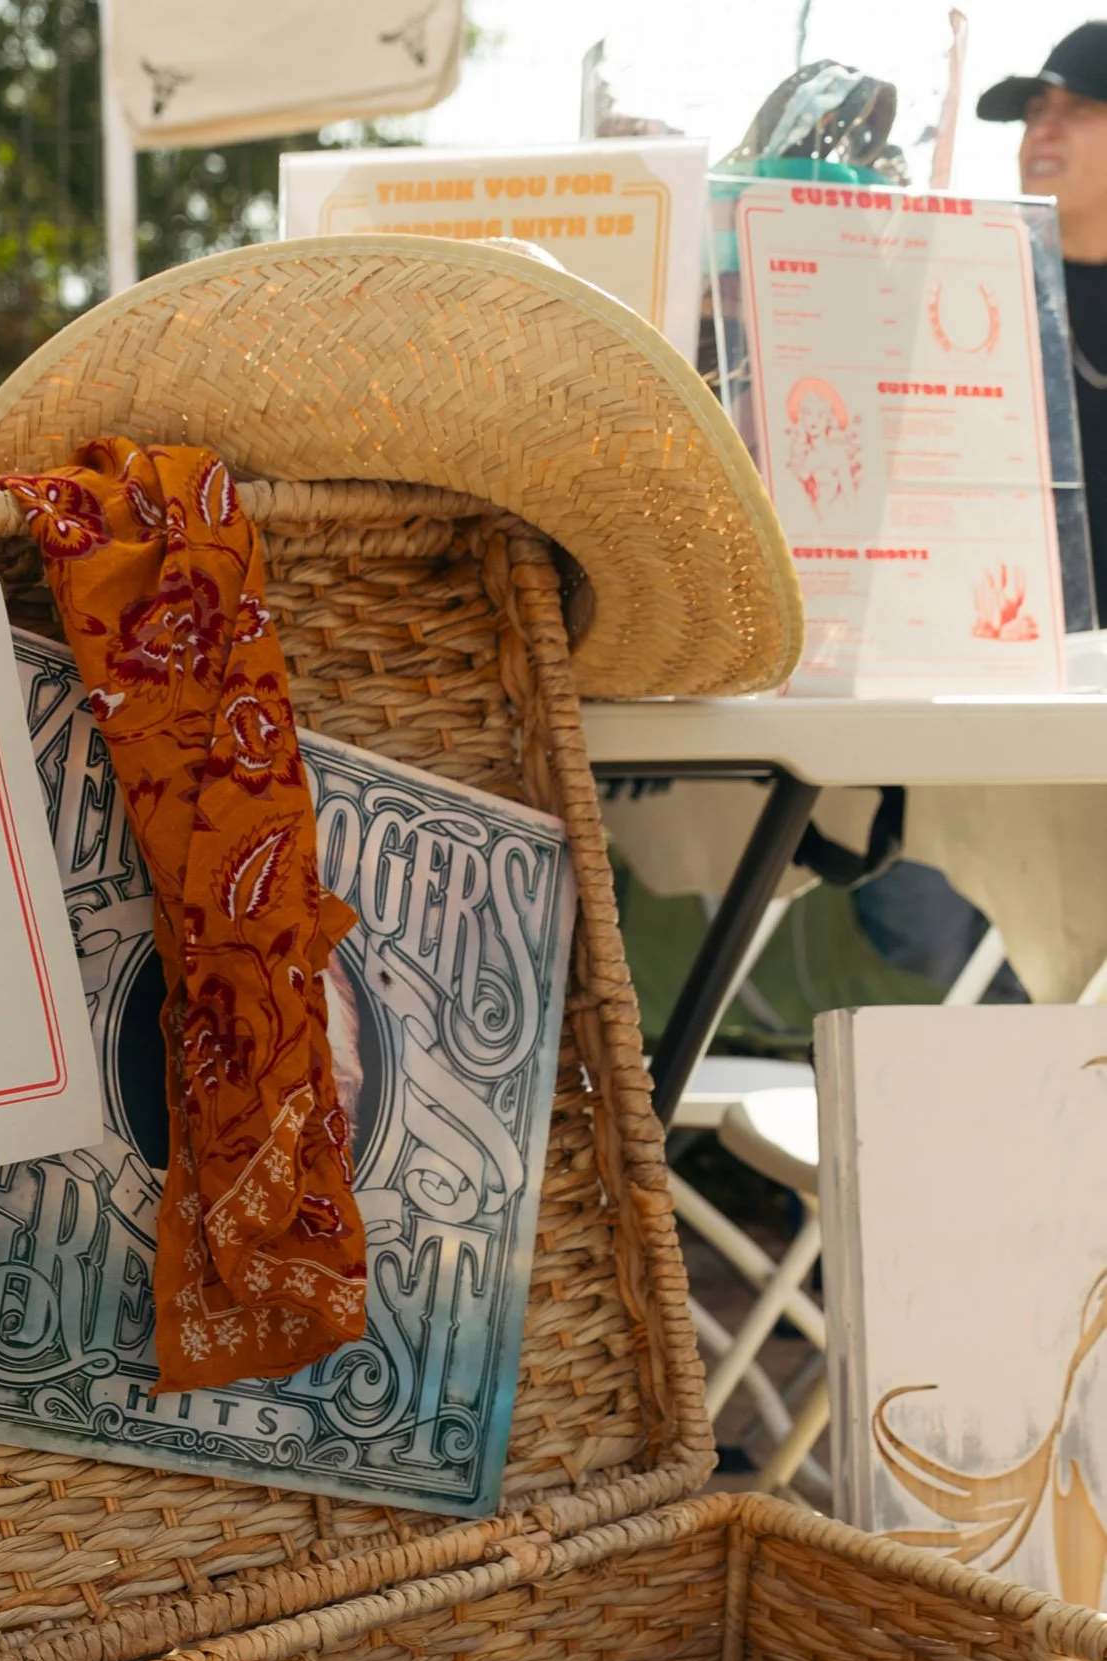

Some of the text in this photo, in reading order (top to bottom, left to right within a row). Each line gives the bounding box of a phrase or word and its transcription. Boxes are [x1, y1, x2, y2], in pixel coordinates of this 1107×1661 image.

[376, 172, 614, 203] THANK YOU FOR
[789, 186, 974, 216] CUSTOM JEANS
[511, 216, 588, 239] WITH
[595, 214, 635, 236] US
[768, 258, 818, 275] LEVIS
[876, 381, 1006, 401] CUSTOM JEANS
[791, 545, 930, 562] CUSTOM SHORTS
[302, 760, 542, 1081] OGERS
[125, 1383, 280, 1436] HITS
